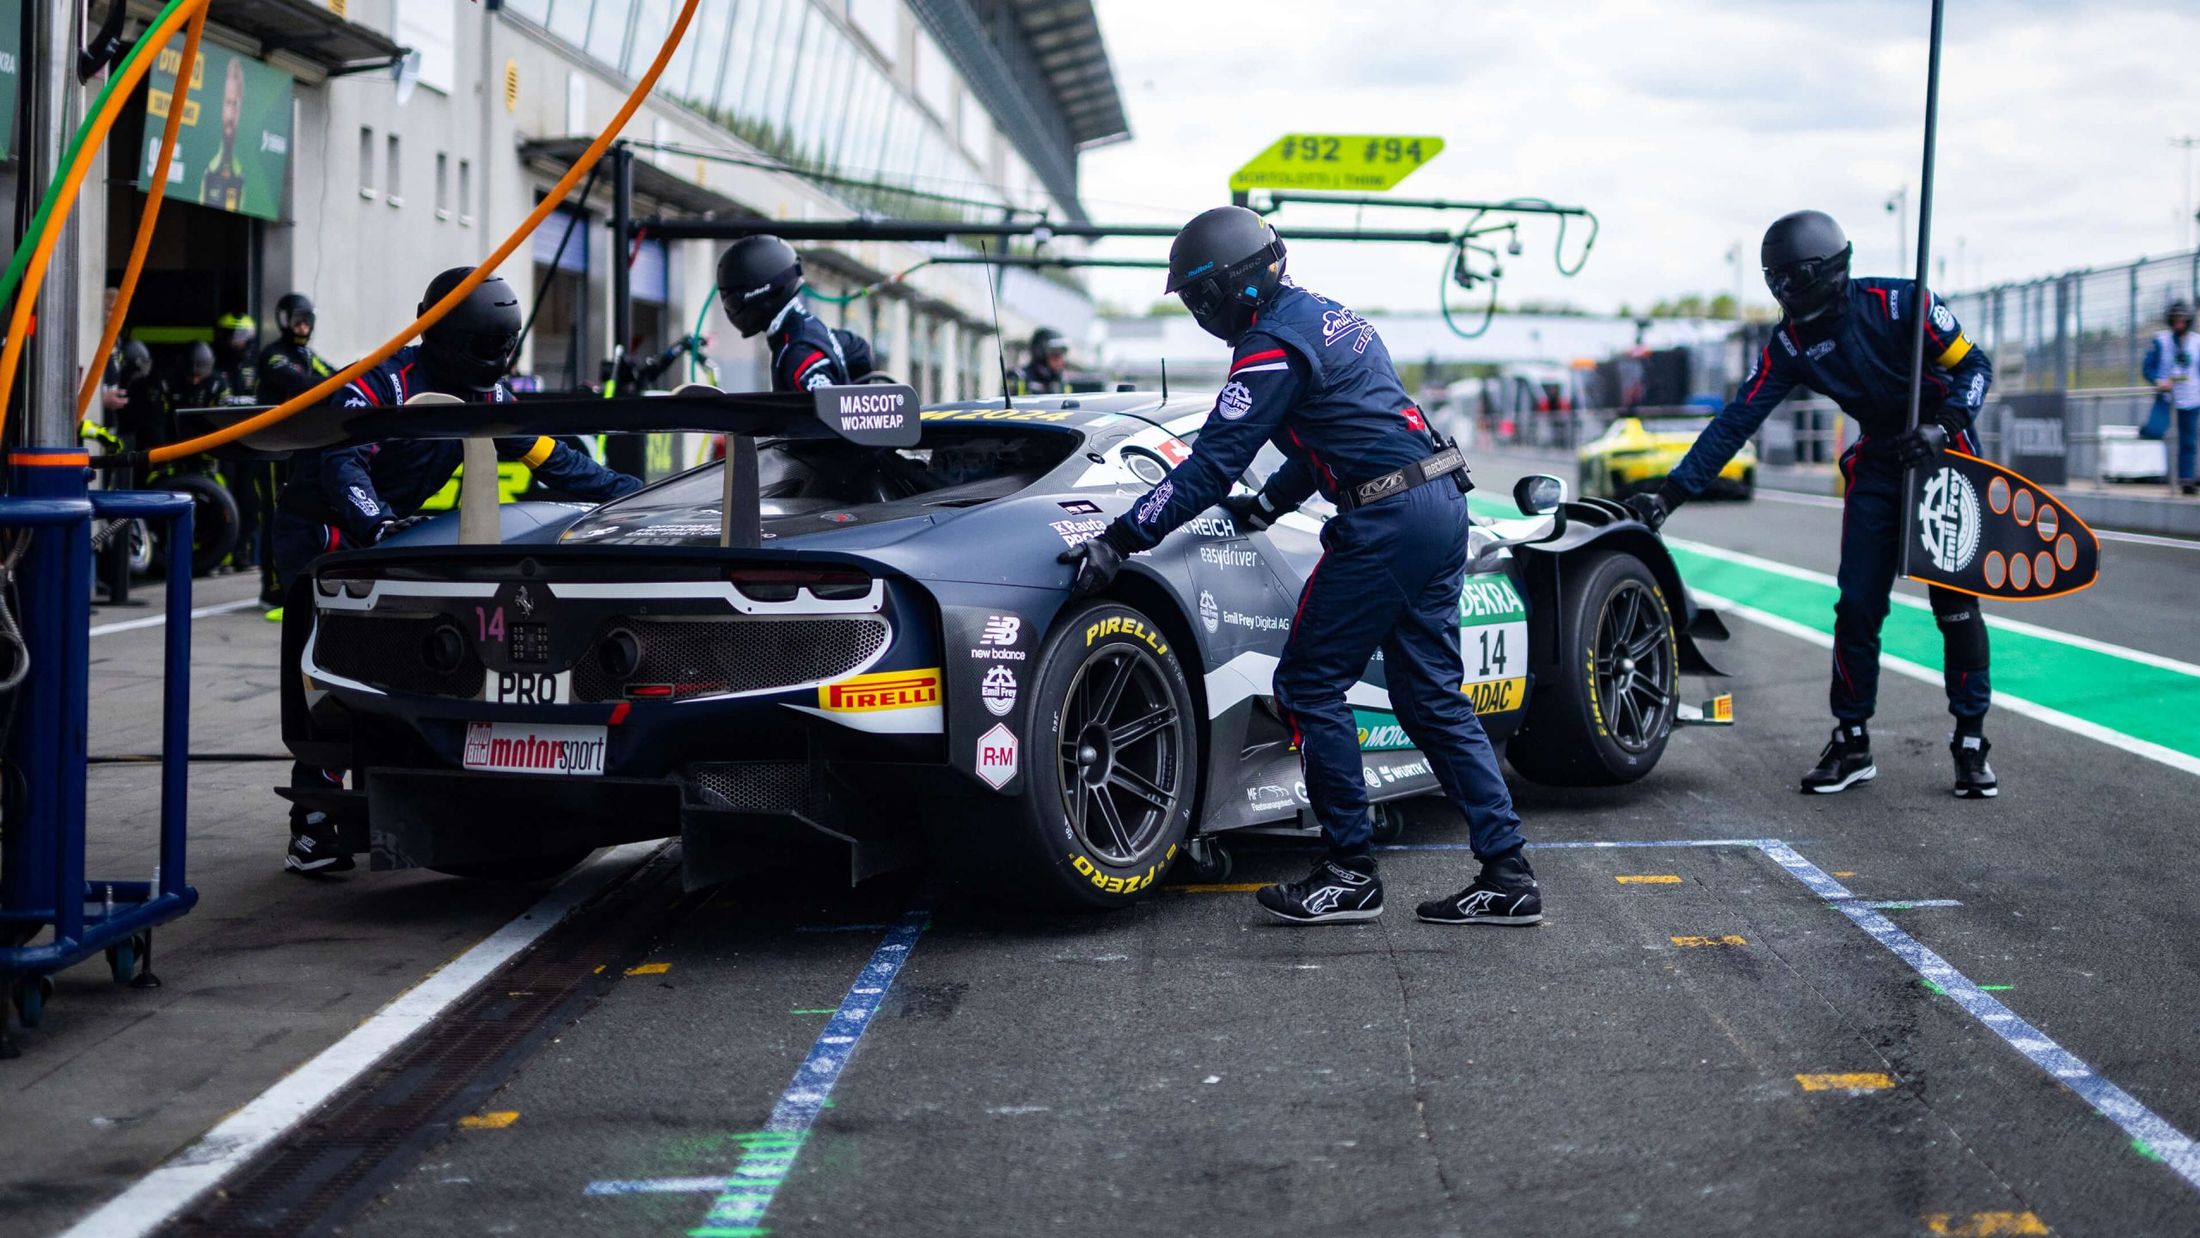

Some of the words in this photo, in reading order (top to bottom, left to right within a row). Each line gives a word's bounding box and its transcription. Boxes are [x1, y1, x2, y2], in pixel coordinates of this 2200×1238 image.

[1281, 136, 1341, 162] #92
[1365, 137, 1423, 164] #94
[1948, 467, 1963, 519] Frey
[1190, 518, 1236, 537] REICH
[1200, 544, 1258, 571] easydriver
[1943, 522, 1958, 573] Emil
[1461, 580, 1525, 617] DEKRA
[475, 606, 506, 642] 14
[1086, 616, 1168, 656] PIRELLI
[1223, 610, 1238, 624] Emil
[1239, 613, 1254, 630] Frey
[1255, 615, 1277, 632] Digital
[1278, 618, 1290, 631] AG
[971, 649, 991, 659] new
[992, 648, 1026, 661] balance
[1479, 629, 1507, 676] 14
[498, 672, 557, 704] PRO
[829, 676, 938, 708] PIRELLI
[982, 686, 1000, 697] Emil
[1000, 686, 1017, 699] Frey
[1470, 680, 1513, 714] ADAC
[468, 724, 491, 745] Auto
[983, 746, 1014, 767] R-M
